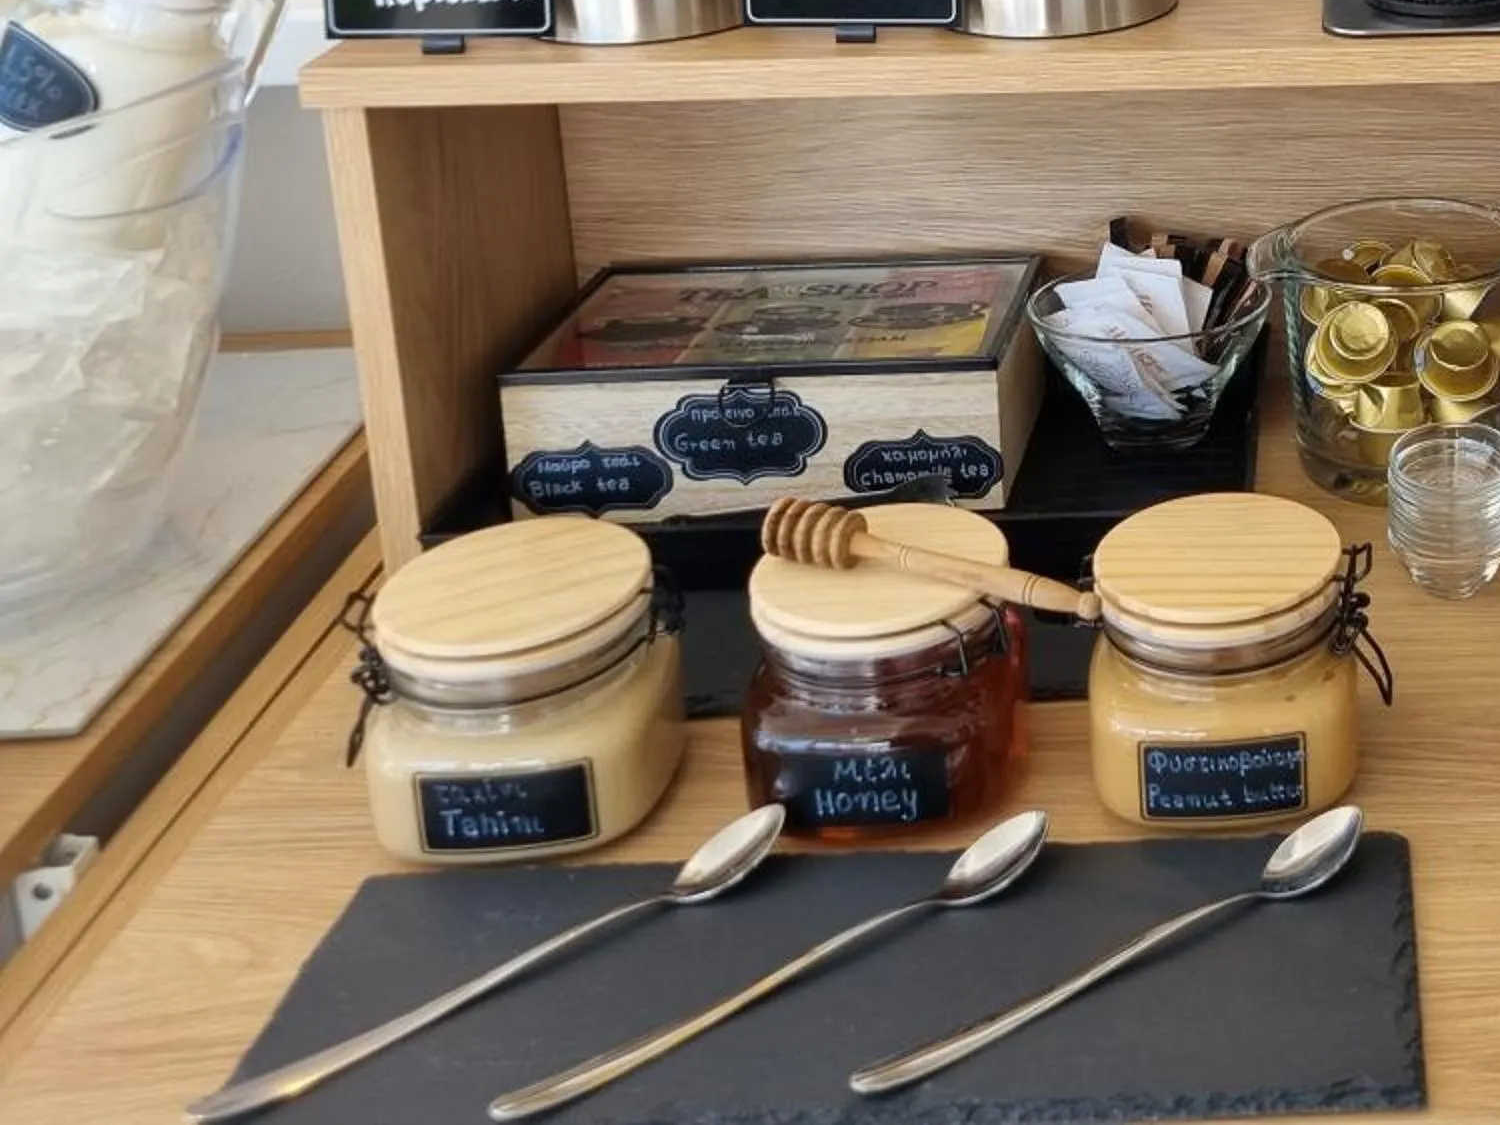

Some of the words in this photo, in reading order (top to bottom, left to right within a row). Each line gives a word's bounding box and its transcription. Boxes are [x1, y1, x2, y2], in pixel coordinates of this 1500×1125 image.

[675, 432, 736, 452] Green
[746, 431, 783, 447] tea
[960, 463, 990, 479] tea
[529, 479, 584, 498] Black
[596, 477, 630, 491] tea
[815, 787, 918, 820] Honey
[1149, 782, 1233, 809] Peanut
